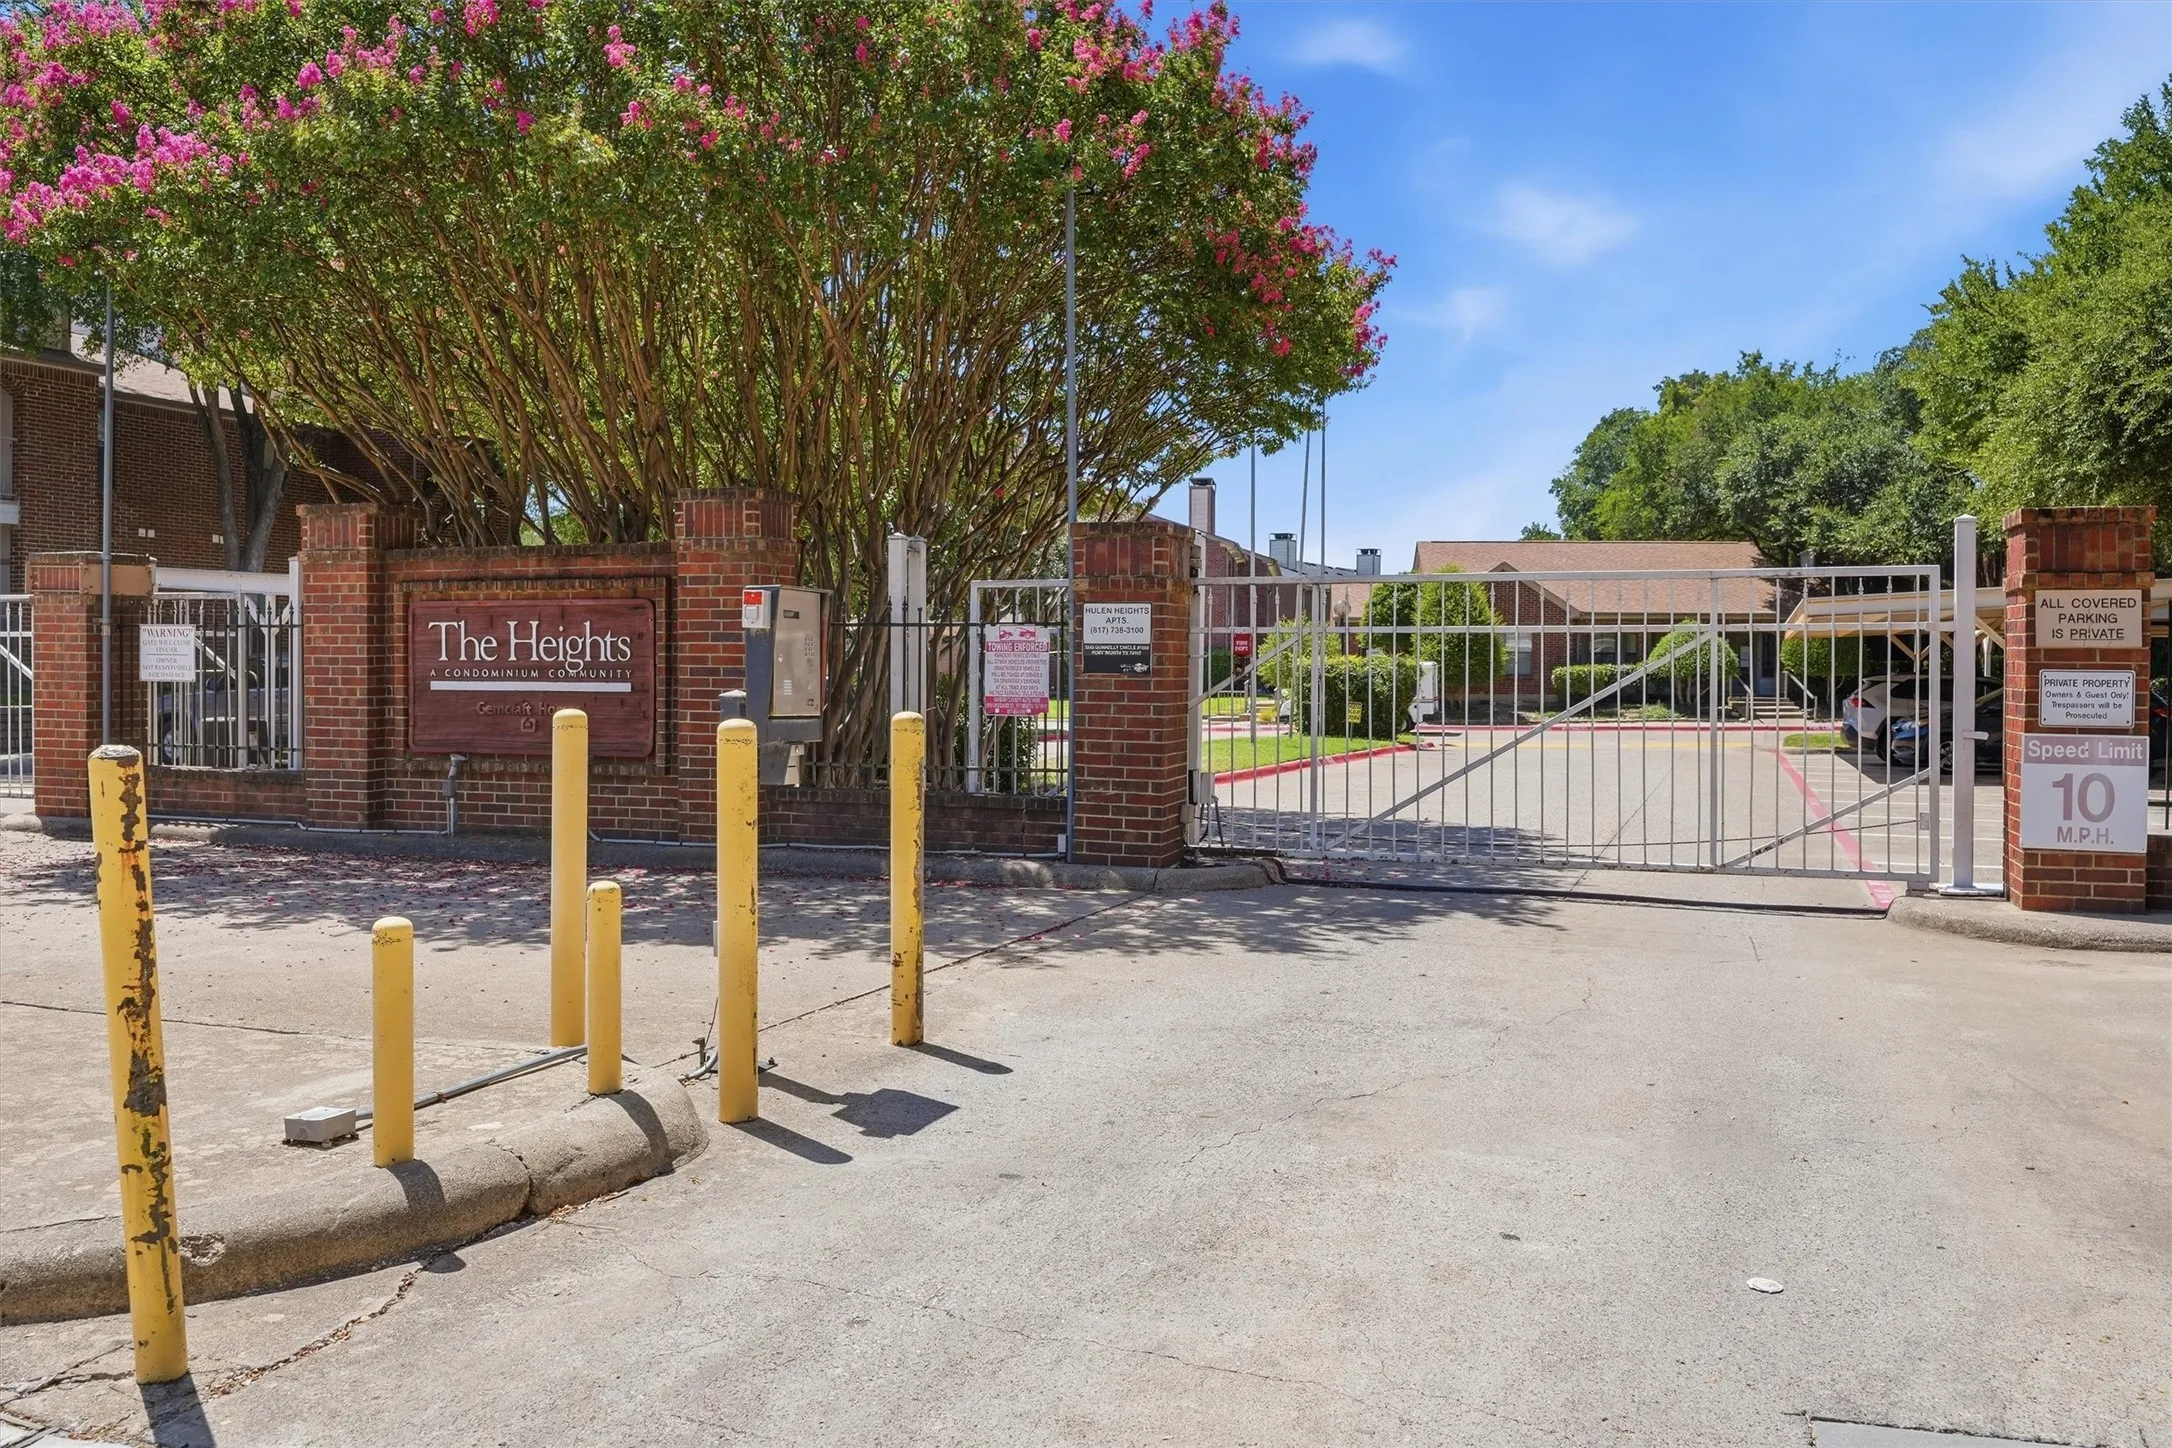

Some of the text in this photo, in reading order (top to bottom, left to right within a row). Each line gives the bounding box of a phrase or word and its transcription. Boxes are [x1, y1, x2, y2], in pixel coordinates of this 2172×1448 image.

[2040, 597, 2137, 609] ALL COVERED
[1085, 607, 1150, 615] HULEN HEIGHTS
[2058, 613, 2118, 624] PARKING
[1090, 626, 1144, 635] (817) 738-3100
[2051, 628, 2125, 640] IS PRIVATE
[427, 619, 631, 672] The Heights
[987, 642, 1048, 652] TOWING ENFORCED
[430, 668, 633, 679] A CONDOMINIUM COMMUNITY
[2043, 678, 2130, 688] PRIVATE PROPERTY
[2045, 690, 2073, 699] Owners
[2085, 691, 2107, 699] Guest
[2051, 700, 2123, 711] Trespassers will be
[2065, 711, 2108, 720] Prosecuted
[2028, 739, 2143, 761] Speed Limit
[2052, 772, 2116, 823] 10
[2056, 826, 2114, 845] M.P.H.
